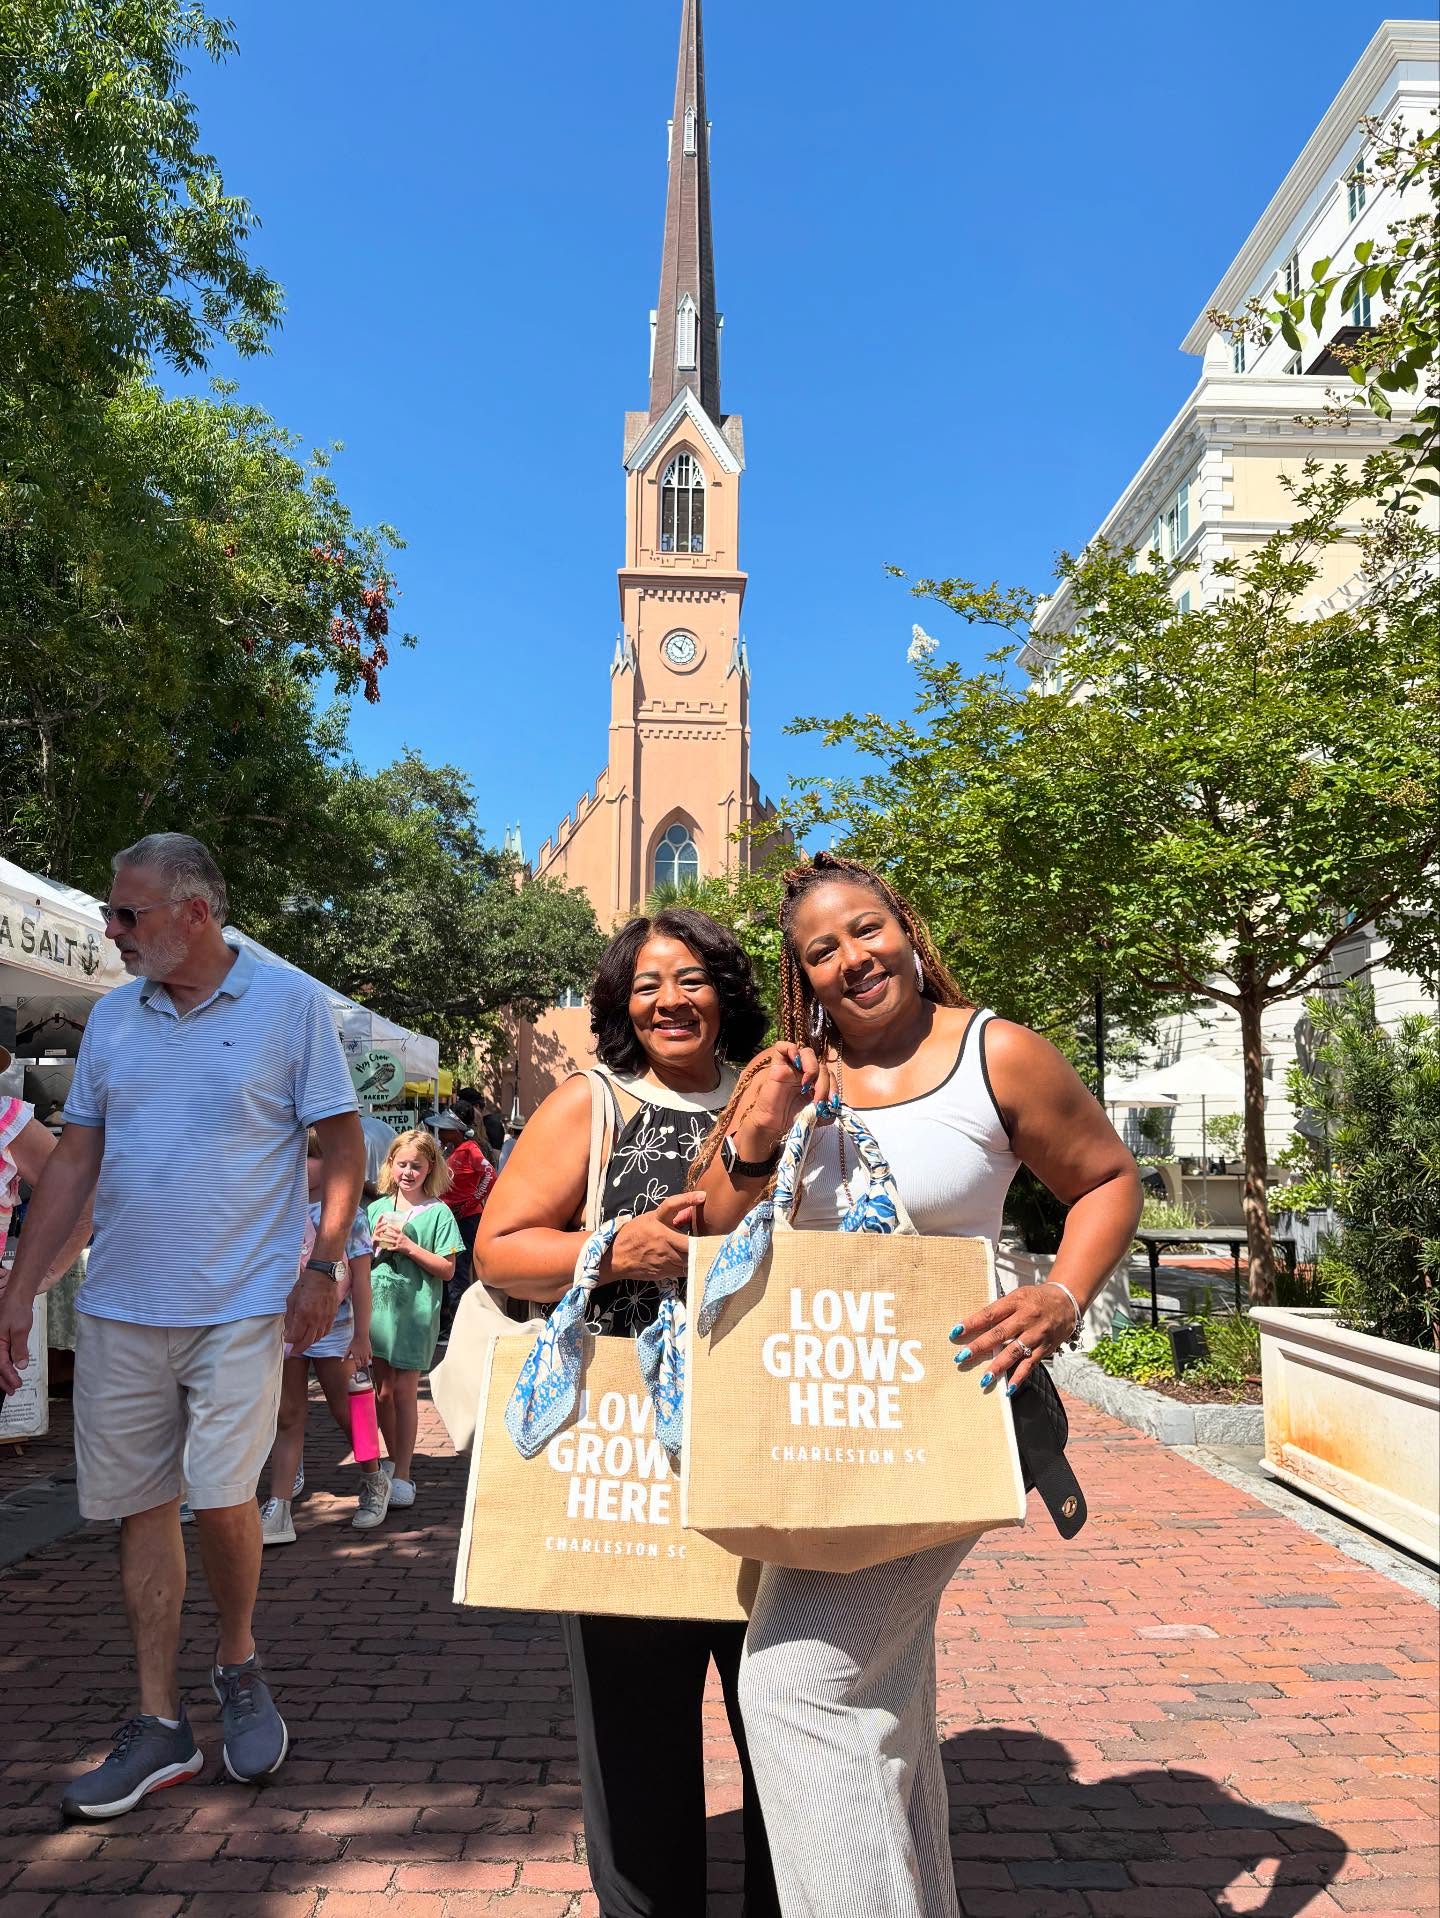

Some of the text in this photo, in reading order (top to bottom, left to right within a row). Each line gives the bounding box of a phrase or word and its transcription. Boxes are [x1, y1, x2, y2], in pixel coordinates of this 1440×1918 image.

[21, 917, 77, 966] SALT
[369, 1053, 390, 1062] Crow
[372, 1115, 409, 1124] AFTED
[474, 1165, 493, 1200] Columbia
[790, 1287, 896, 1335] LOVE
[762, 1333, 926, 1383] GROWS
[576, 1389, 658, 1435] LOV
[789, 1382, 903, 1429] HERE
[547, 1431, 681, 1482] GROW
[770, 1446, 928, 1465] CHARLESTON SC
[566, 1476, 672, 1525] HERE
[544, 1536, 687, 1559] CHARLESTON SC
